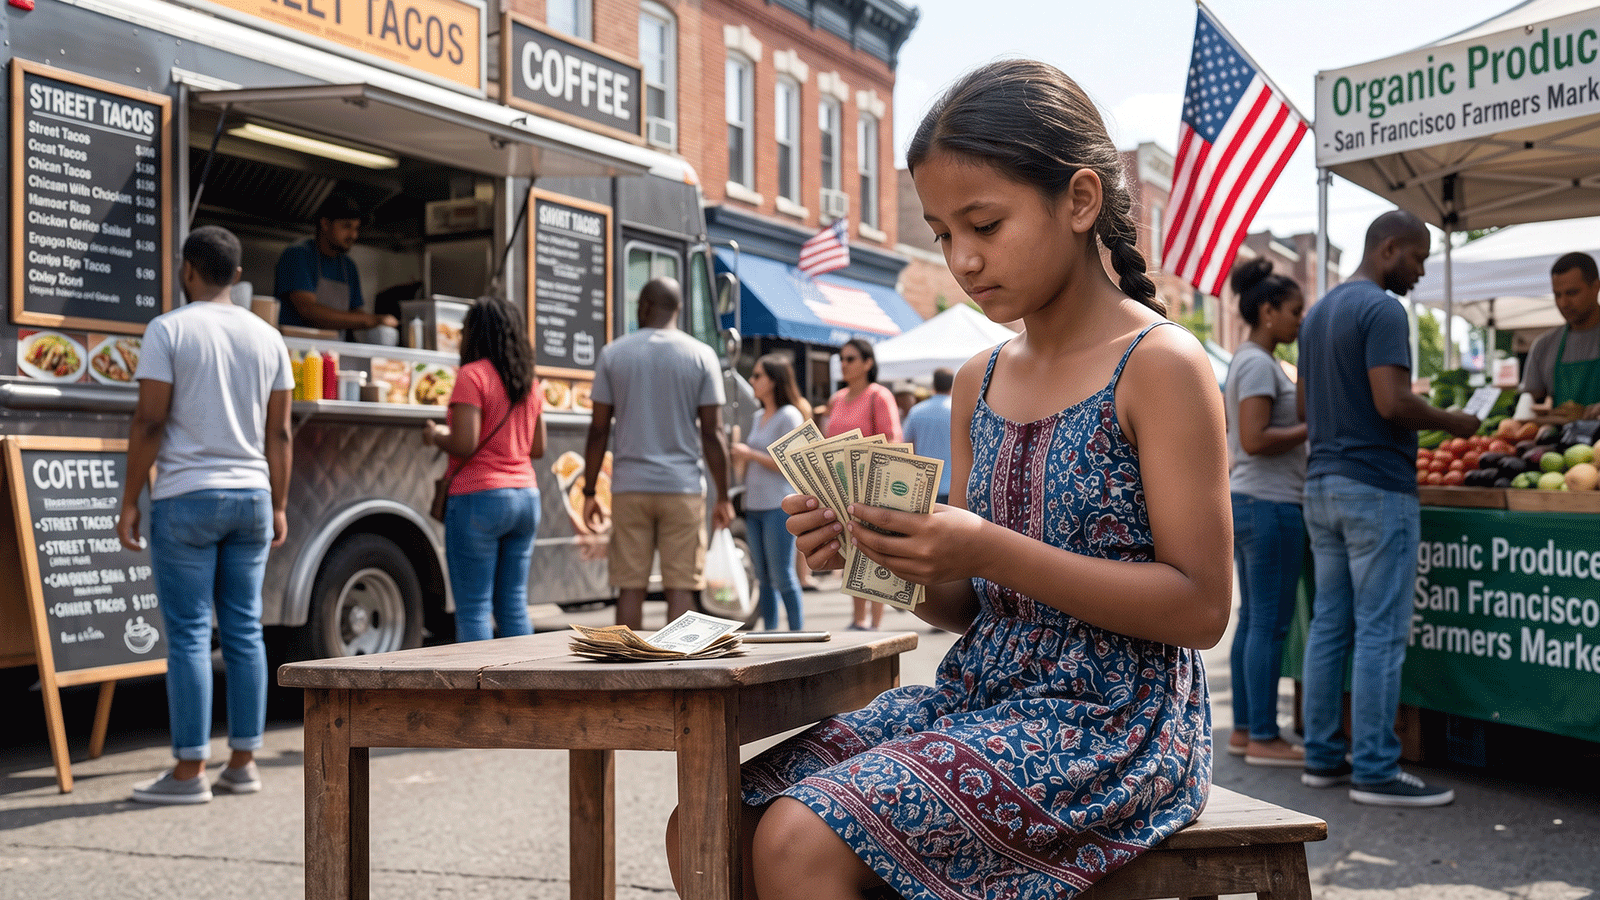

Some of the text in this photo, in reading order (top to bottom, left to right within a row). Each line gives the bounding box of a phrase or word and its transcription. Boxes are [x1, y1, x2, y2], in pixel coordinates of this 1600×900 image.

[367, 0, 465, 65] TACOS
[522, 40, 631, 121] COFFEE
[1332, 28, 1599, 120] Organic Produc
[30, 83, 155, 135] STREET TACOS
[1334, 129, 1365, 152] San
[1370, 112, 1456, 145] Francisco
[1463, 94, 1541, 127] Farmers
[28, 120, 91, 145] Street Tacos
[58, 144, 88, 162] Tacos
[62, 162, 92, 180] Tacos
[83, 258, 112, 274] Tacos
[33, 459, 119, 489] COFFEE
[40, 516, 114, 532] STREET TACOS
[45, 538, 122, 555] STREET TACOS
[1491, 536, 1600, 581] Produce
[1414, 576, 1600, 628] San Francisco
[1409, 614, 1512, 660] Farmers
